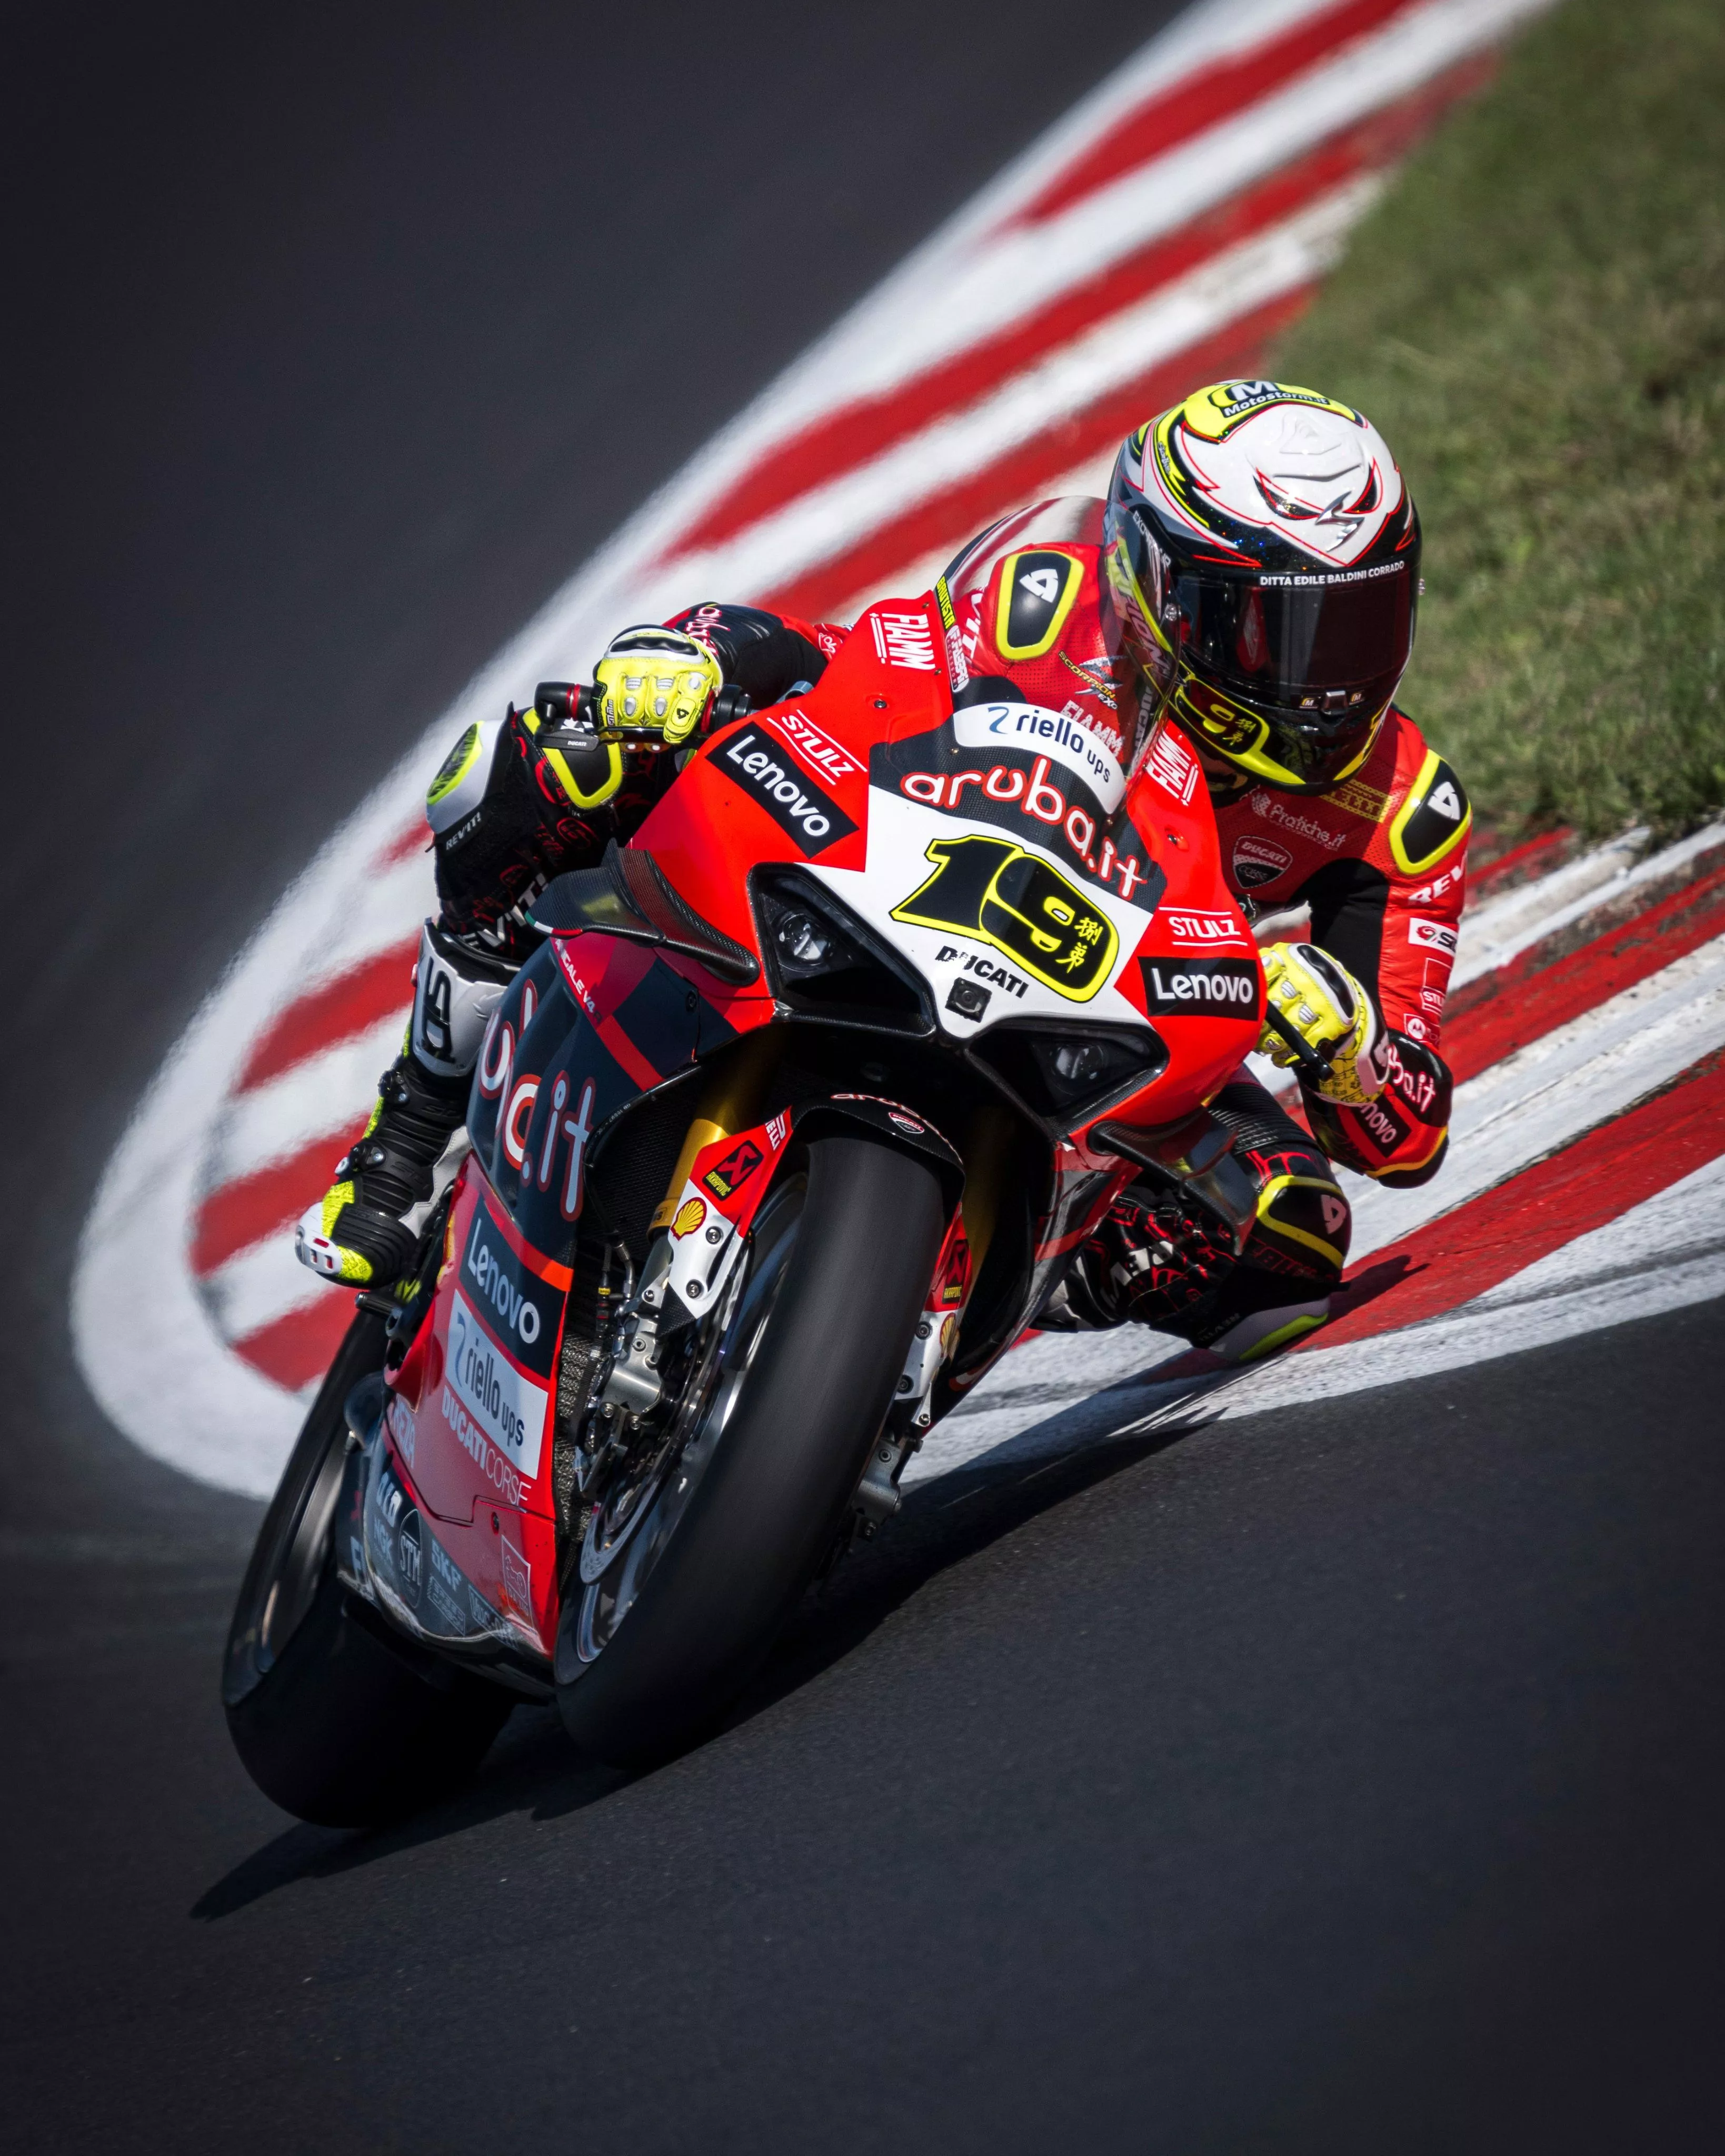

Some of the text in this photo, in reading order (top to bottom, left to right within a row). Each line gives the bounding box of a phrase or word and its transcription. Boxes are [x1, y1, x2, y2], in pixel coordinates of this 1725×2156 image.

[1224, 391, 1328, 416] Motostorm.it
[1260, 560, 1404, 585] DITTA EDILE BALDINI CORRADO
[936, 576, 956, 630] BAUTISTA
[882, 613, 936, 670] FIAMM
[1058, 650, 1116, 699] SCORPION
[1098, 693, 1118, 710] EXO
[781, 715, 855, 778] STULZ
[1016, 710, 1111, 784] riello ups
[1145, 730, 1192, 799] FIAMM
[726, 735, 830, 836] Lenovo
[446, 811, 482, 851] REV'IT!
[901, 756, 1148, 901] aruba.it
[1241, 841, 1288, 864] DUCATI
[889, 834, 1120, 1003] 19
[1169, 917, 1242, 937] STULZ
[934, 945, 1030, 999] DUCATI
[1151, 968, 1253, 1003] Lenovo
[705, 1171, 732, 1196] AKRAPOVIČ
[468, 1218, 540, 1344] Lenovo
[465, 1337, 524, 1448] riello ups
[441, 1384, 487, 1469] DUCATI
[400, 1535, 421, 1586] STM
